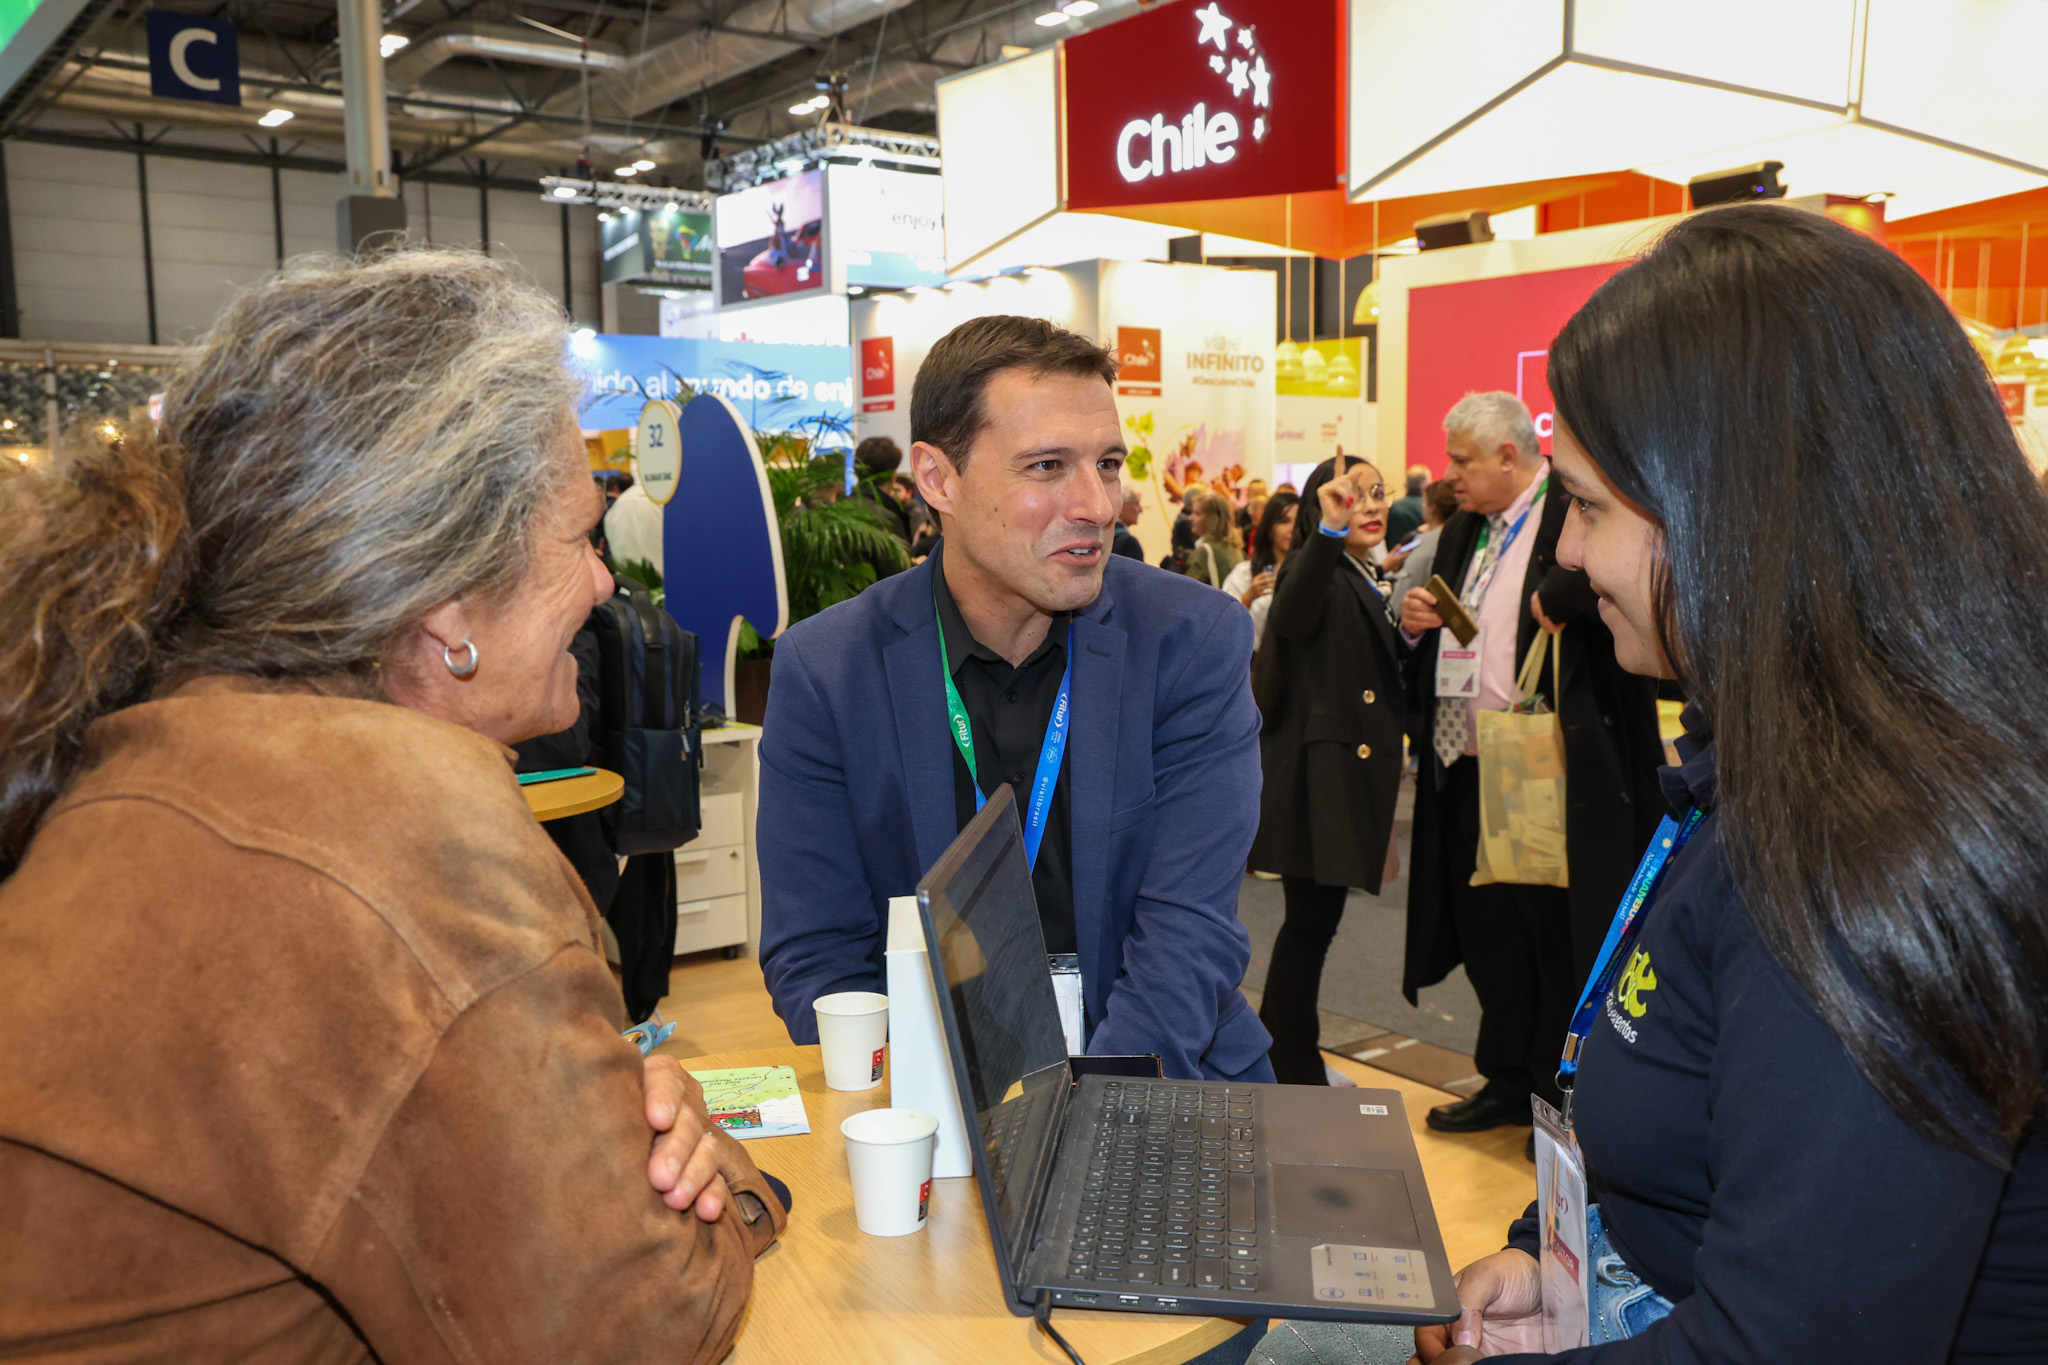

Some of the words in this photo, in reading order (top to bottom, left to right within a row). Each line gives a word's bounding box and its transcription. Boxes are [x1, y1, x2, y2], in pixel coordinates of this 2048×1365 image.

[168, 27, 221, 92] C
[1116, 102, 1239, 183] Chile
[1186, 352, 1264, 373] INFINITO
[645, 370, 668, 398] al
[648, 423, 664, 448] 32
[1032, 777, 1049, 827] @visitbrasil
